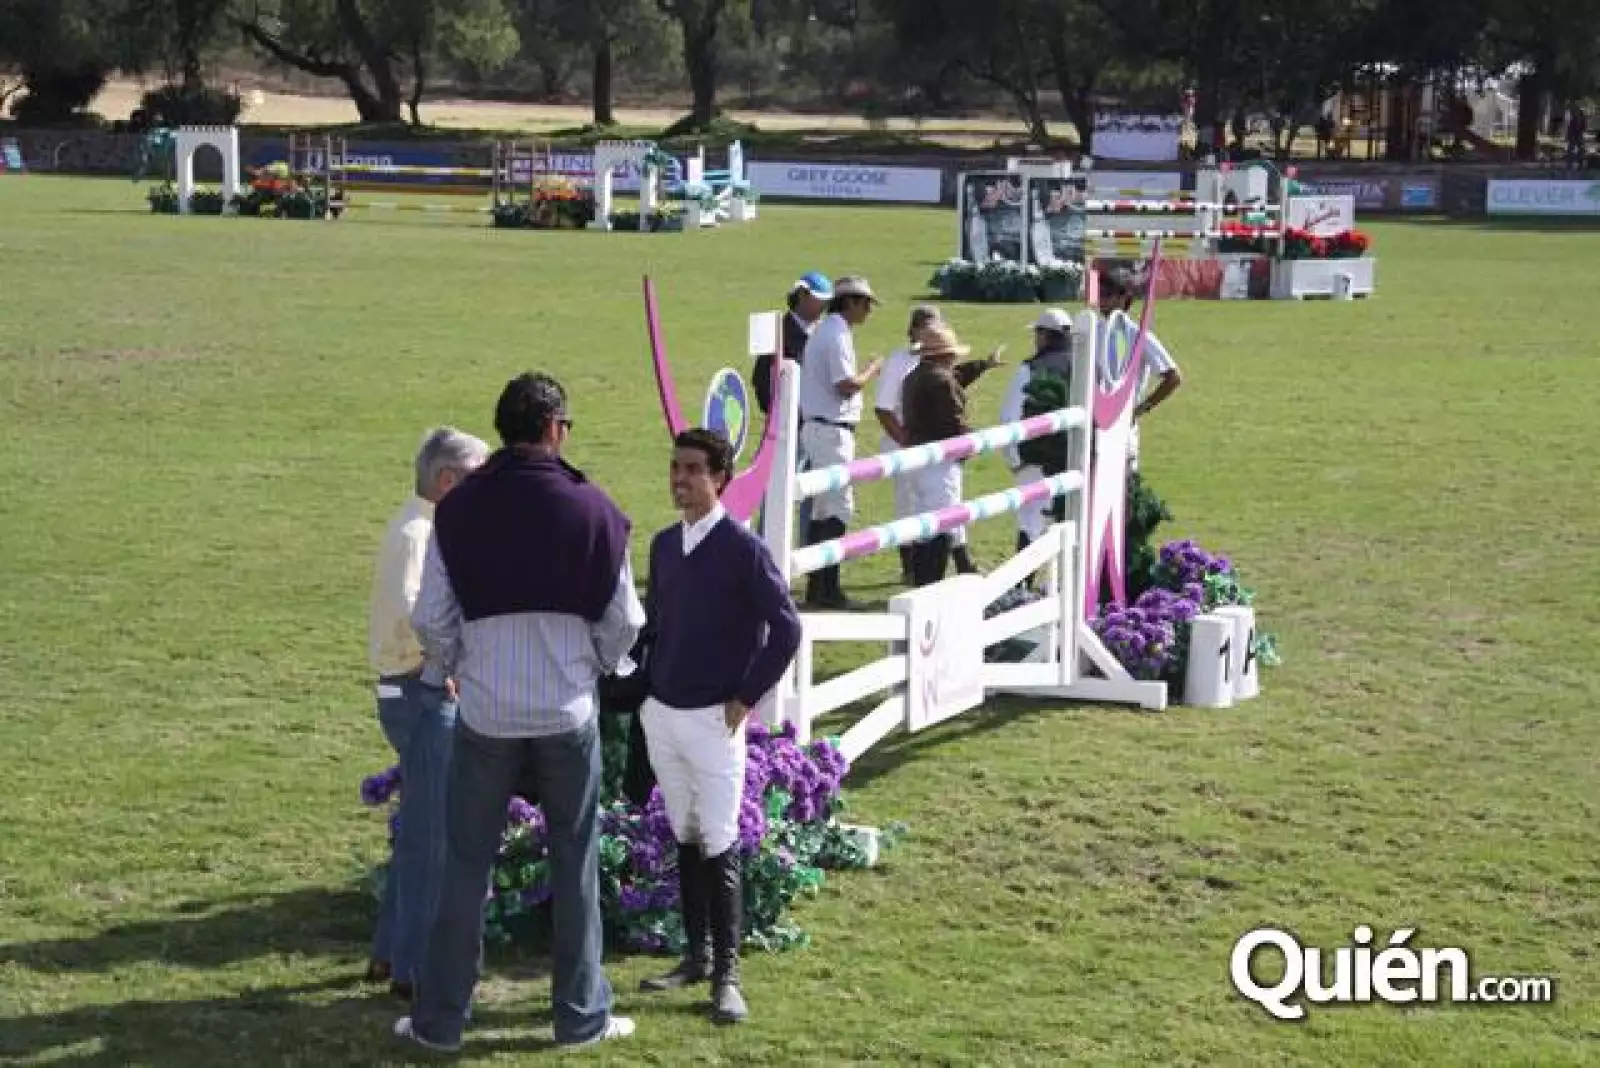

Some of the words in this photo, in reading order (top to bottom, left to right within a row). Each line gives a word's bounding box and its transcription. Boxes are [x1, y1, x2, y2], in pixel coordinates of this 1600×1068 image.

[787, 167, 828, 181] GREY
[832, 169, 887, 184] GOOSE
[1492, 186, 1575, 204] CLEVER
